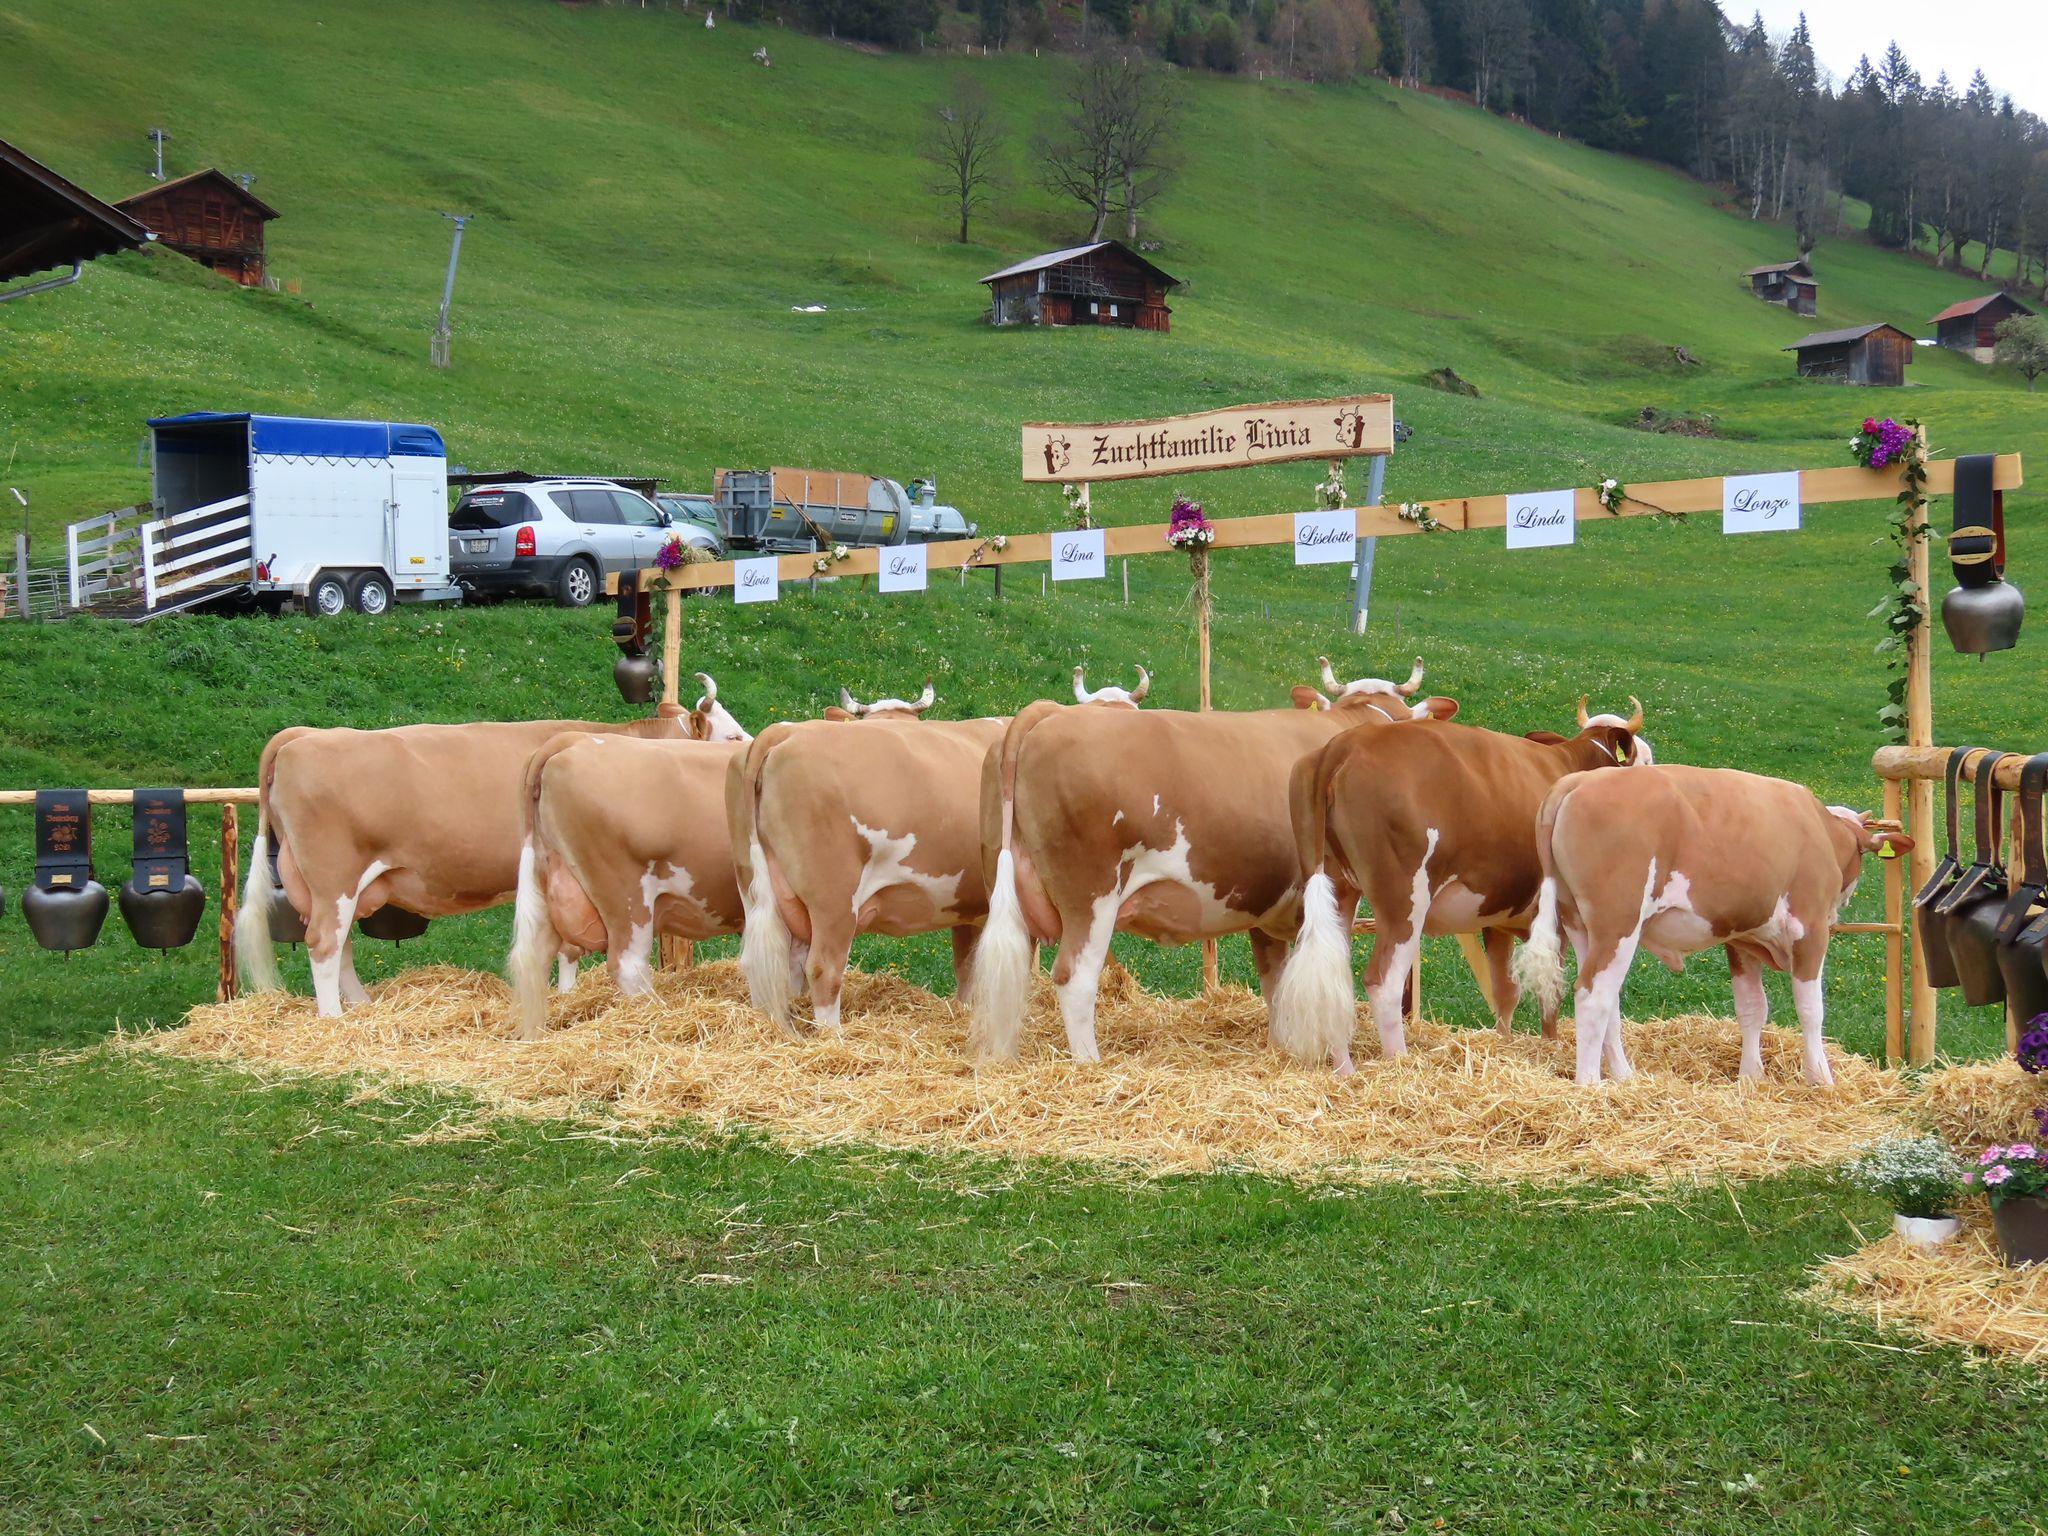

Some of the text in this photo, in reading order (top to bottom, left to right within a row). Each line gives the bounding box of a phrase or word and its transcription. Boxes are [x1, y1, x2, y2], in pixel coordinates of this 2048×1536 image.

[1091, 418, 1312, 470] Zuchtfamilie Livia
[1730, 488, 1790, 519] Lonzo
[1513, 506, 1566, 528] Linda
[1297, 525, 1354, 546] Liselotte
[1059, 543, 1095, 563] Lina
[888, 556, 918, 576] Leni
[741, 568, 771, 588] Livia
